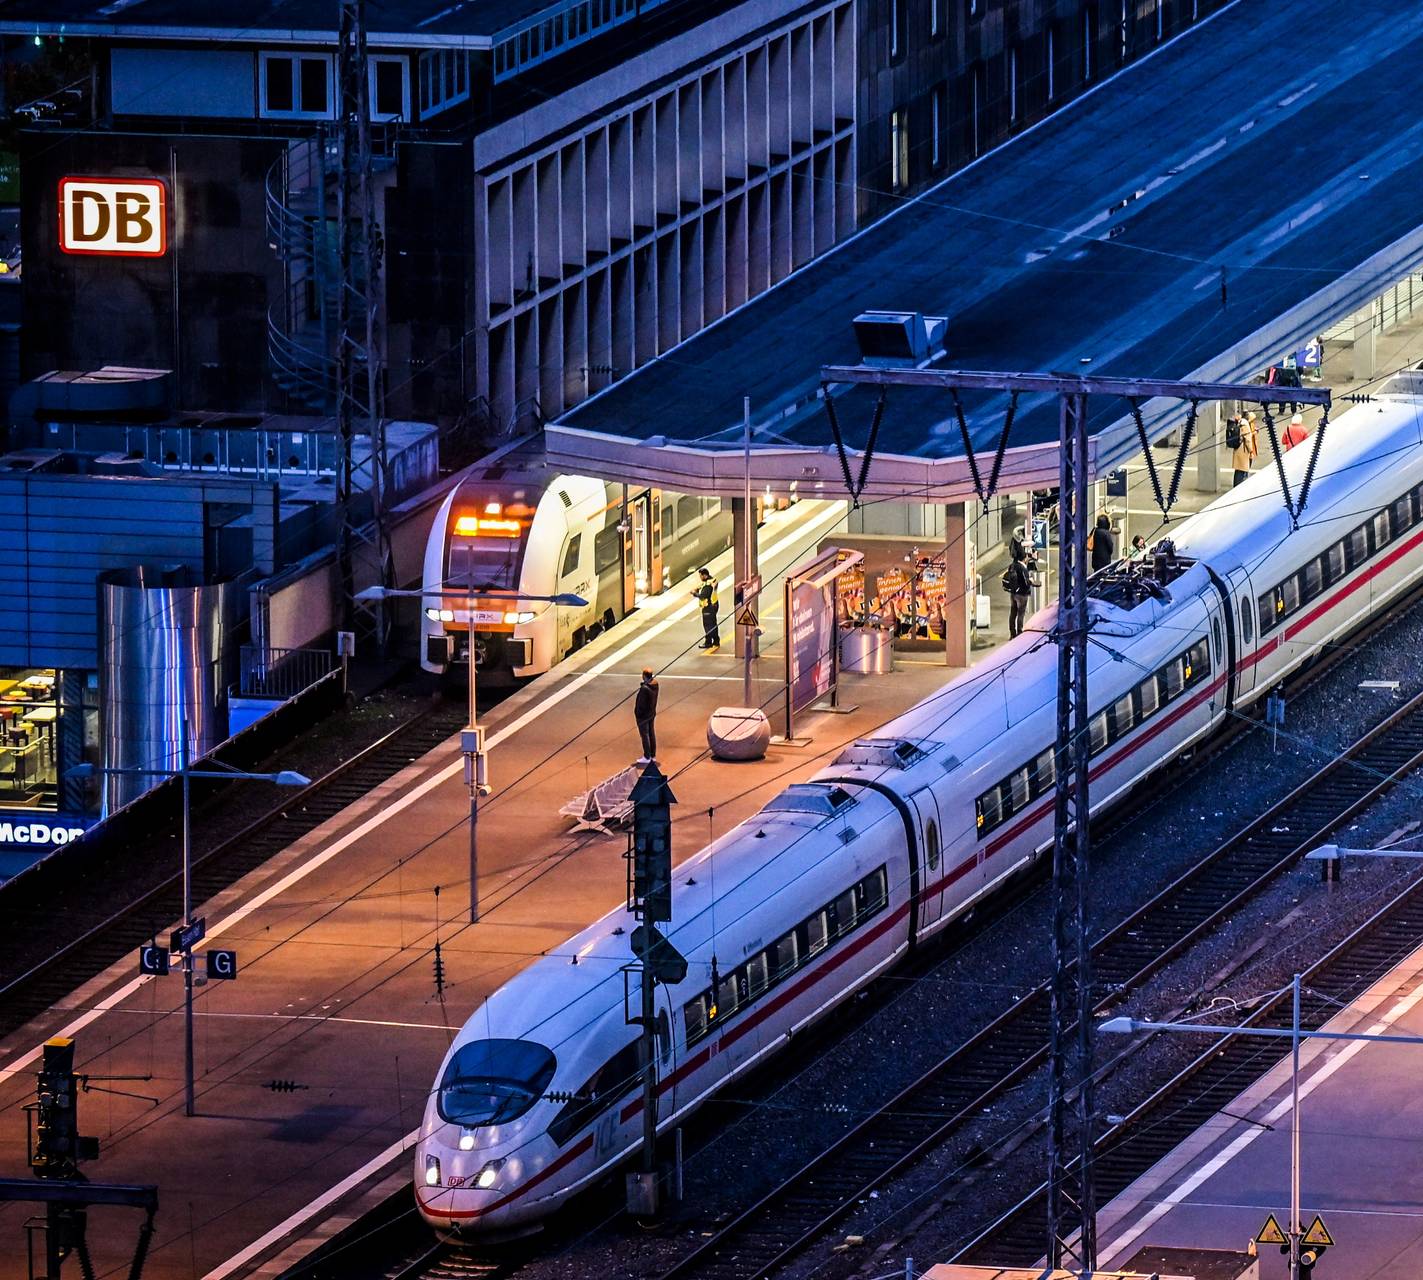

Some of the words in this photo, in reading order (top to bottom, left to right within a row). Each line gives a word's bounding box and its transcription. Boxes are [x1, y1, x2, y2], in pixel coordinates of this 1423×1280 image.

[72, 190, 153, 244] DB
[1305, 344, 1317, 363] 2
[216, 952, 231, 973] G
